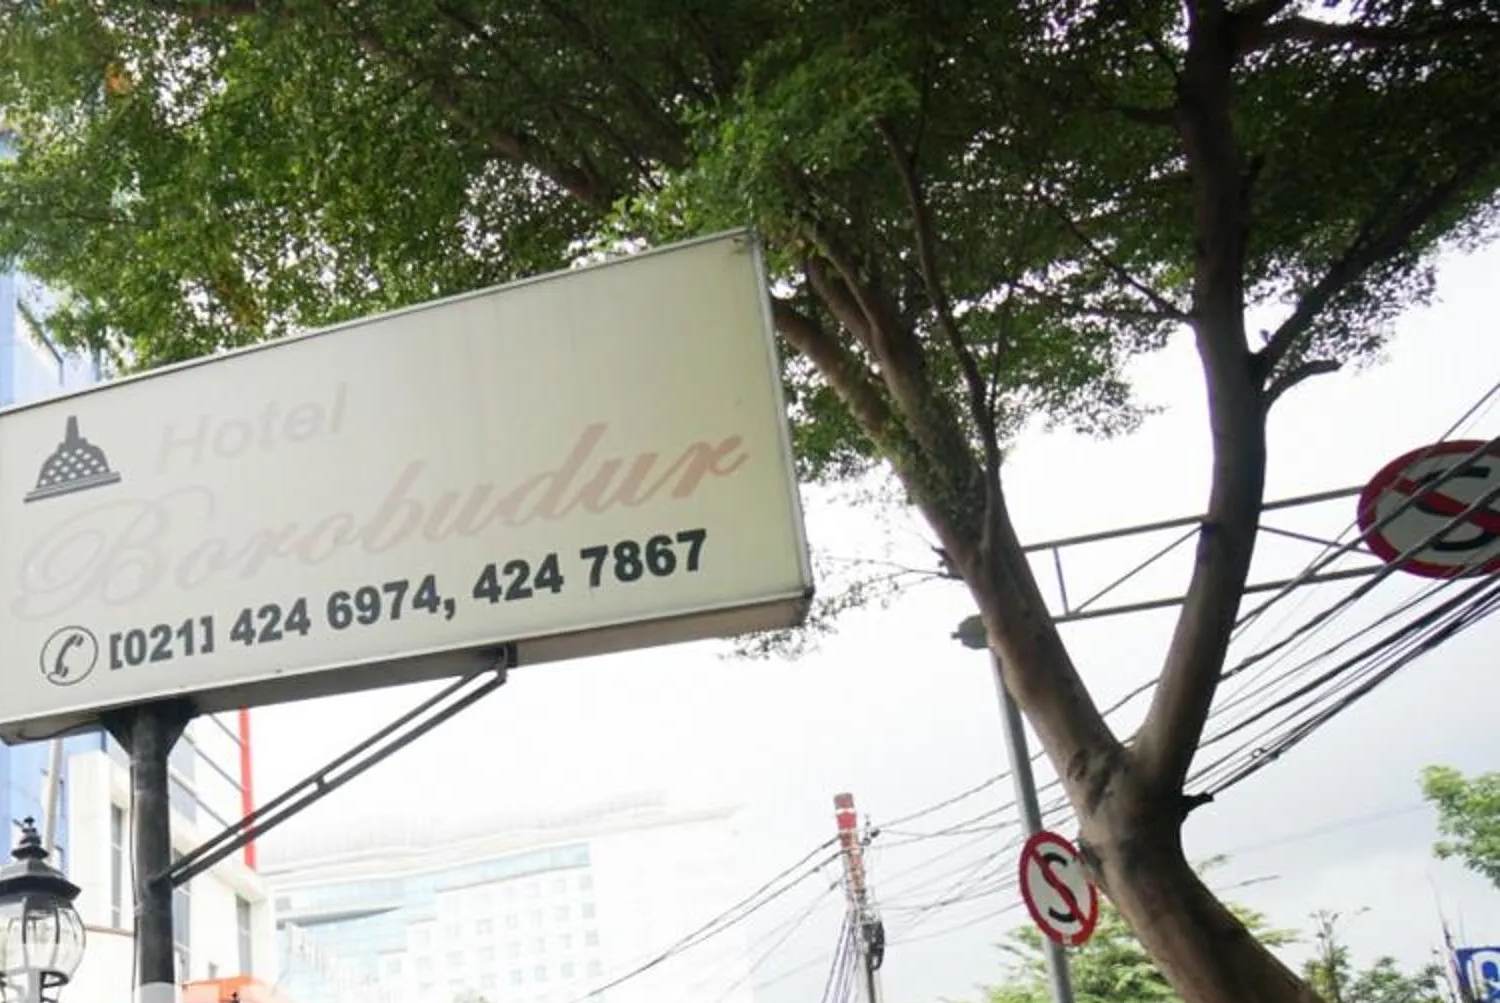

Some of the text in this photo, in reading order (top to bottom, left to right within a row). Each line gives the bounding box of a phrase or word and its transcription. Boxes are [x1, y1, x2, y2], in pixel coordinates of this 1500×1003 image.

[155, 381, 349, 476] Hotel
[11, 421, 749, 621] Borobudur
[230, 597, 312, 646] 424
[326, 573, 456, 621] 6974,
[472, 552, 564, 605] 424
[580, 528, 707, 588] 7867
